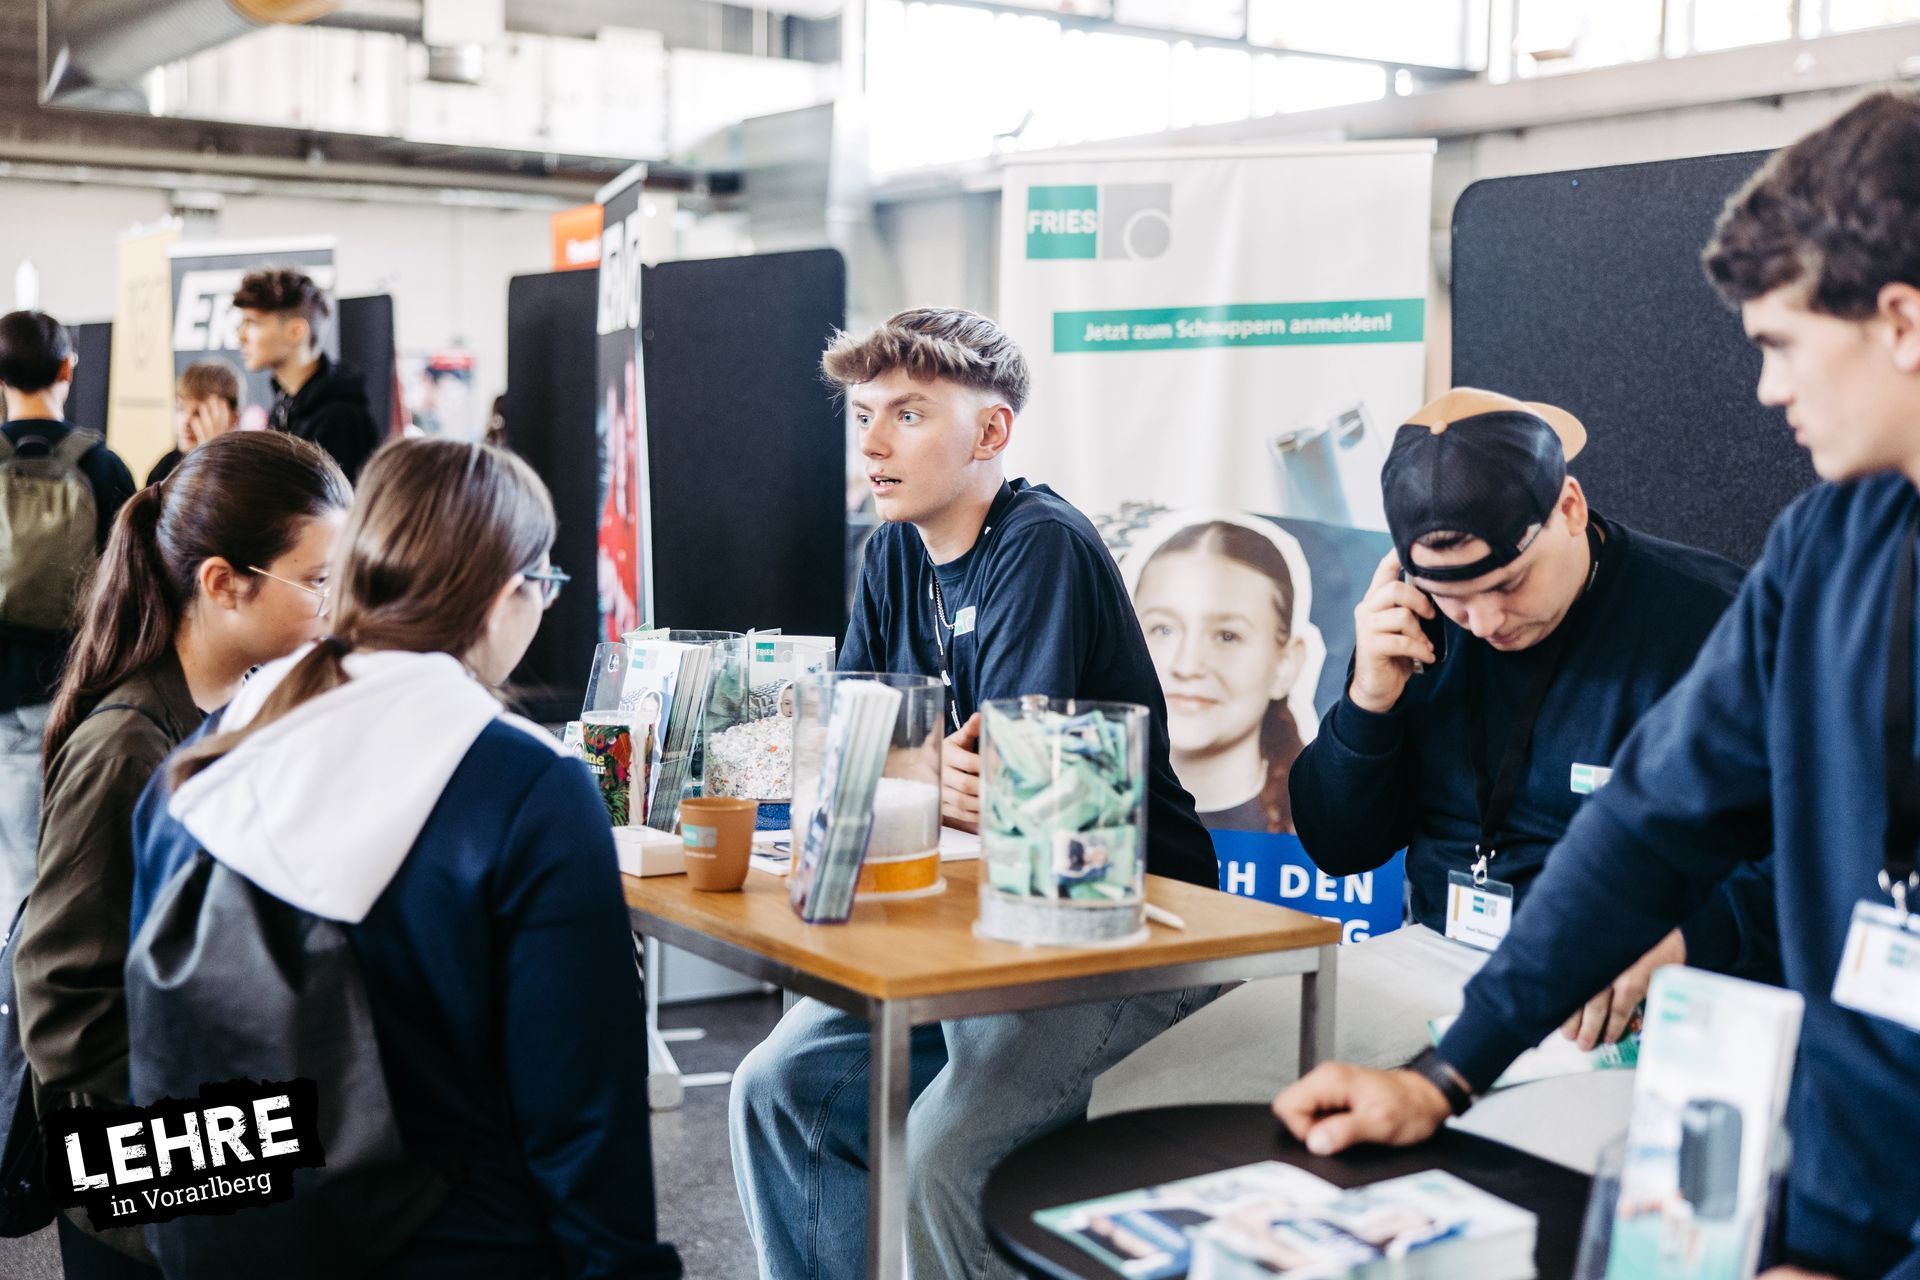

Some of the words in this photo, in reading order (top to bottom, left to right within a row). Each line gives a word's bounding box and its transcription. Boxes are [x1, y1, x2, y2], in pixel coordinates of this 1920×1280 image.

[1028, 208, 1097, 234] FRIES
[1084, 322, 1129, 342] Jetzt
[1132, 323, 1173, 340] zum
[1175, 317, 1287, 340] Schnuppern
[1289, 311, 1393, 335] anmelden!
[1280, 864, 1374, 905] DEN
